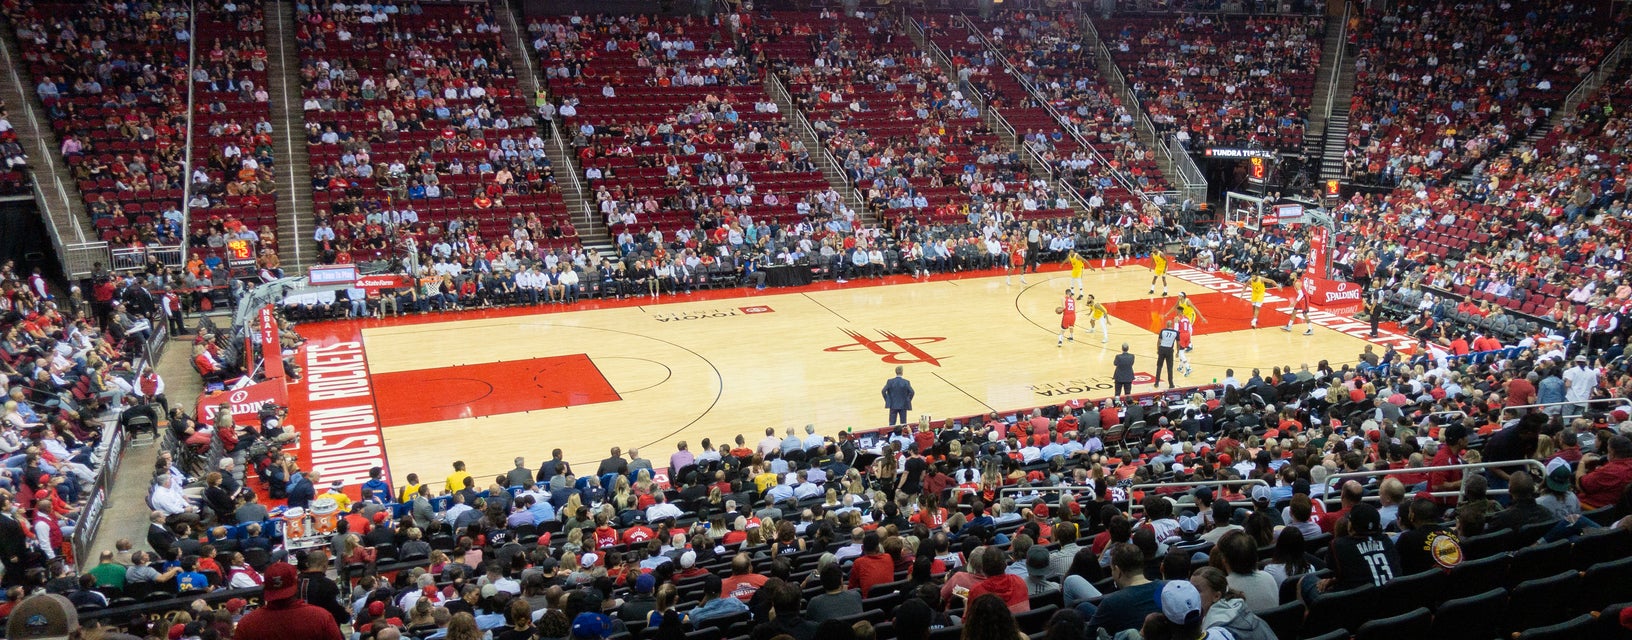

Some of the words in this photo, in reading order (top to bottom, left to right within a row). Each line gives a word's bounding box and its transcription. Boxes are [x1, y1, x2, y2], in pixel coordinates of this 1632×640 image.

[238, 248, 249, 258] 12
[1325, 289, 1360, 303] SPALDING
[263, 309, 271, 329] NBA
[655, 312, 740, 322] TOYOTA
[265, 331, 273, 344] TV
[306, 341, 371, 401] ROCKETS
[1035, 383, 1114, 397] OYOTA
[309, 405, 387, 489] HOUSTON
[932, 514, 943, 525] 13
[1356, 540, 1385, 554] HARDEN
[1423, 531, 1437, 550] BACK
[1363, 552, 1394, 587] 13
